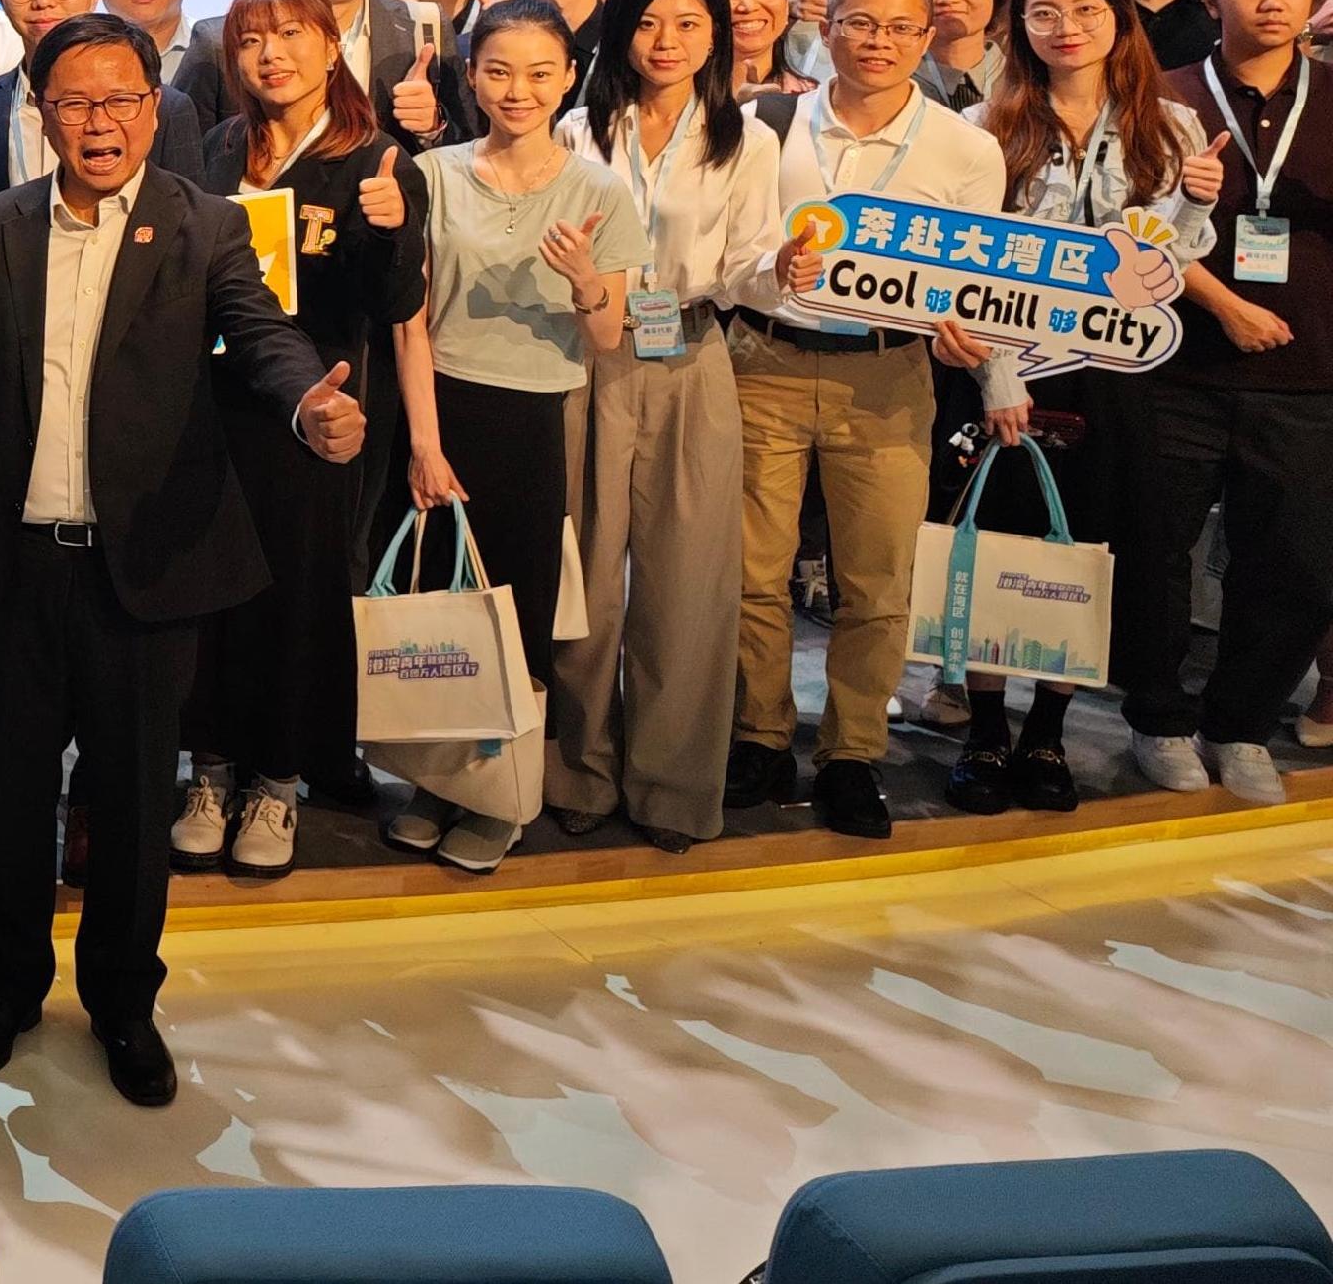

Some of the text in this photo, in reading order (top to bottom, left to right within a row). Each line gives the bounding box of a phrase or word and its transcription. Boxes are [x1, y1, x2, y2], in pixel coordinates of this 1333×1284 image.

[853, 206, 1095, 285] 奔赴大湾区
[831, 261, 1162, 359] Cool 够 Chill 够 City
